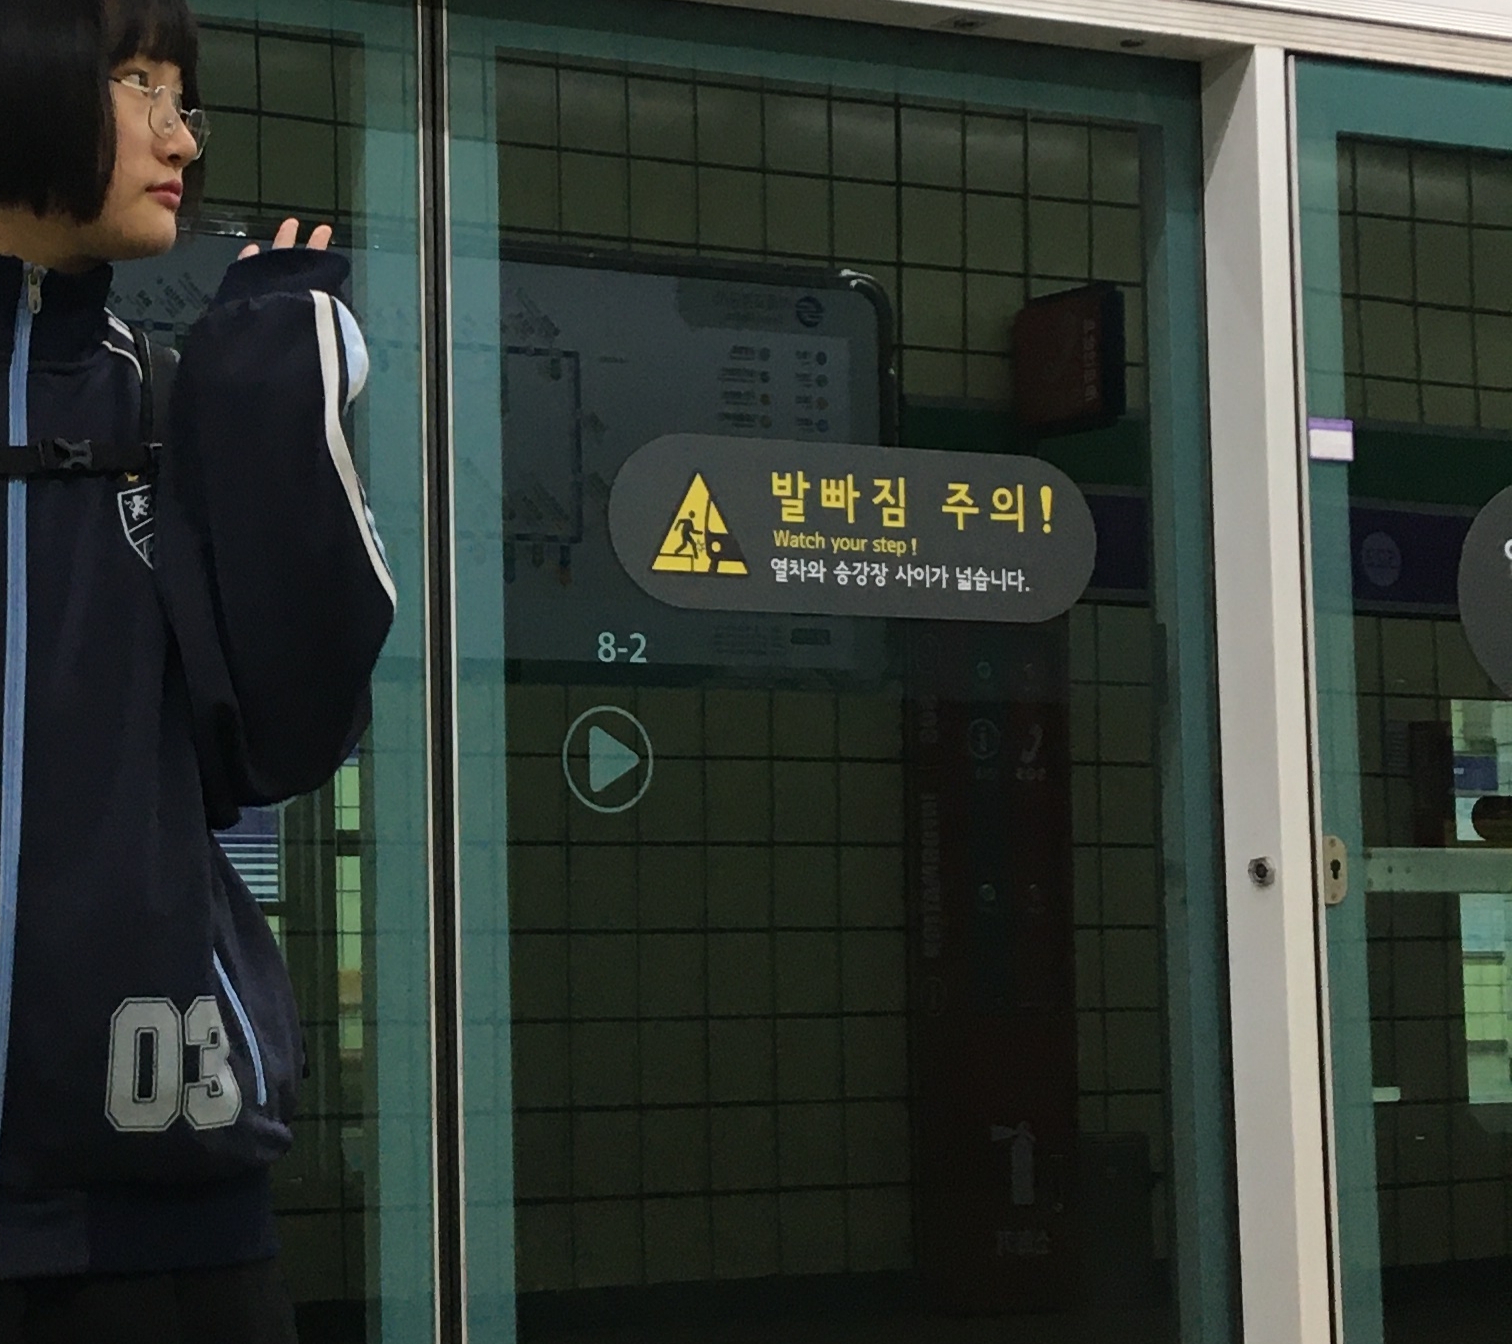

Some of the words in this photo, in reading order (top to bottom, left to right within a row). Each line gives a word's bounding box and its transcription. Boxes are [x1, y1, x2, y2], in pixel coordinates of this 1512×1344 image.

[773, 529, 826, 549] Watch
[830, 535, 868, 554] your
[770, 556, 827, 584] 열차와
[832, 560, 889, 587] 승강장
[894, 562, 950, 589] 사이가
[955, 565, 1031, 592] 넓습니다.
[597, 631, 648, 664] 8-2
[104, 994, 243, 1132] 03
